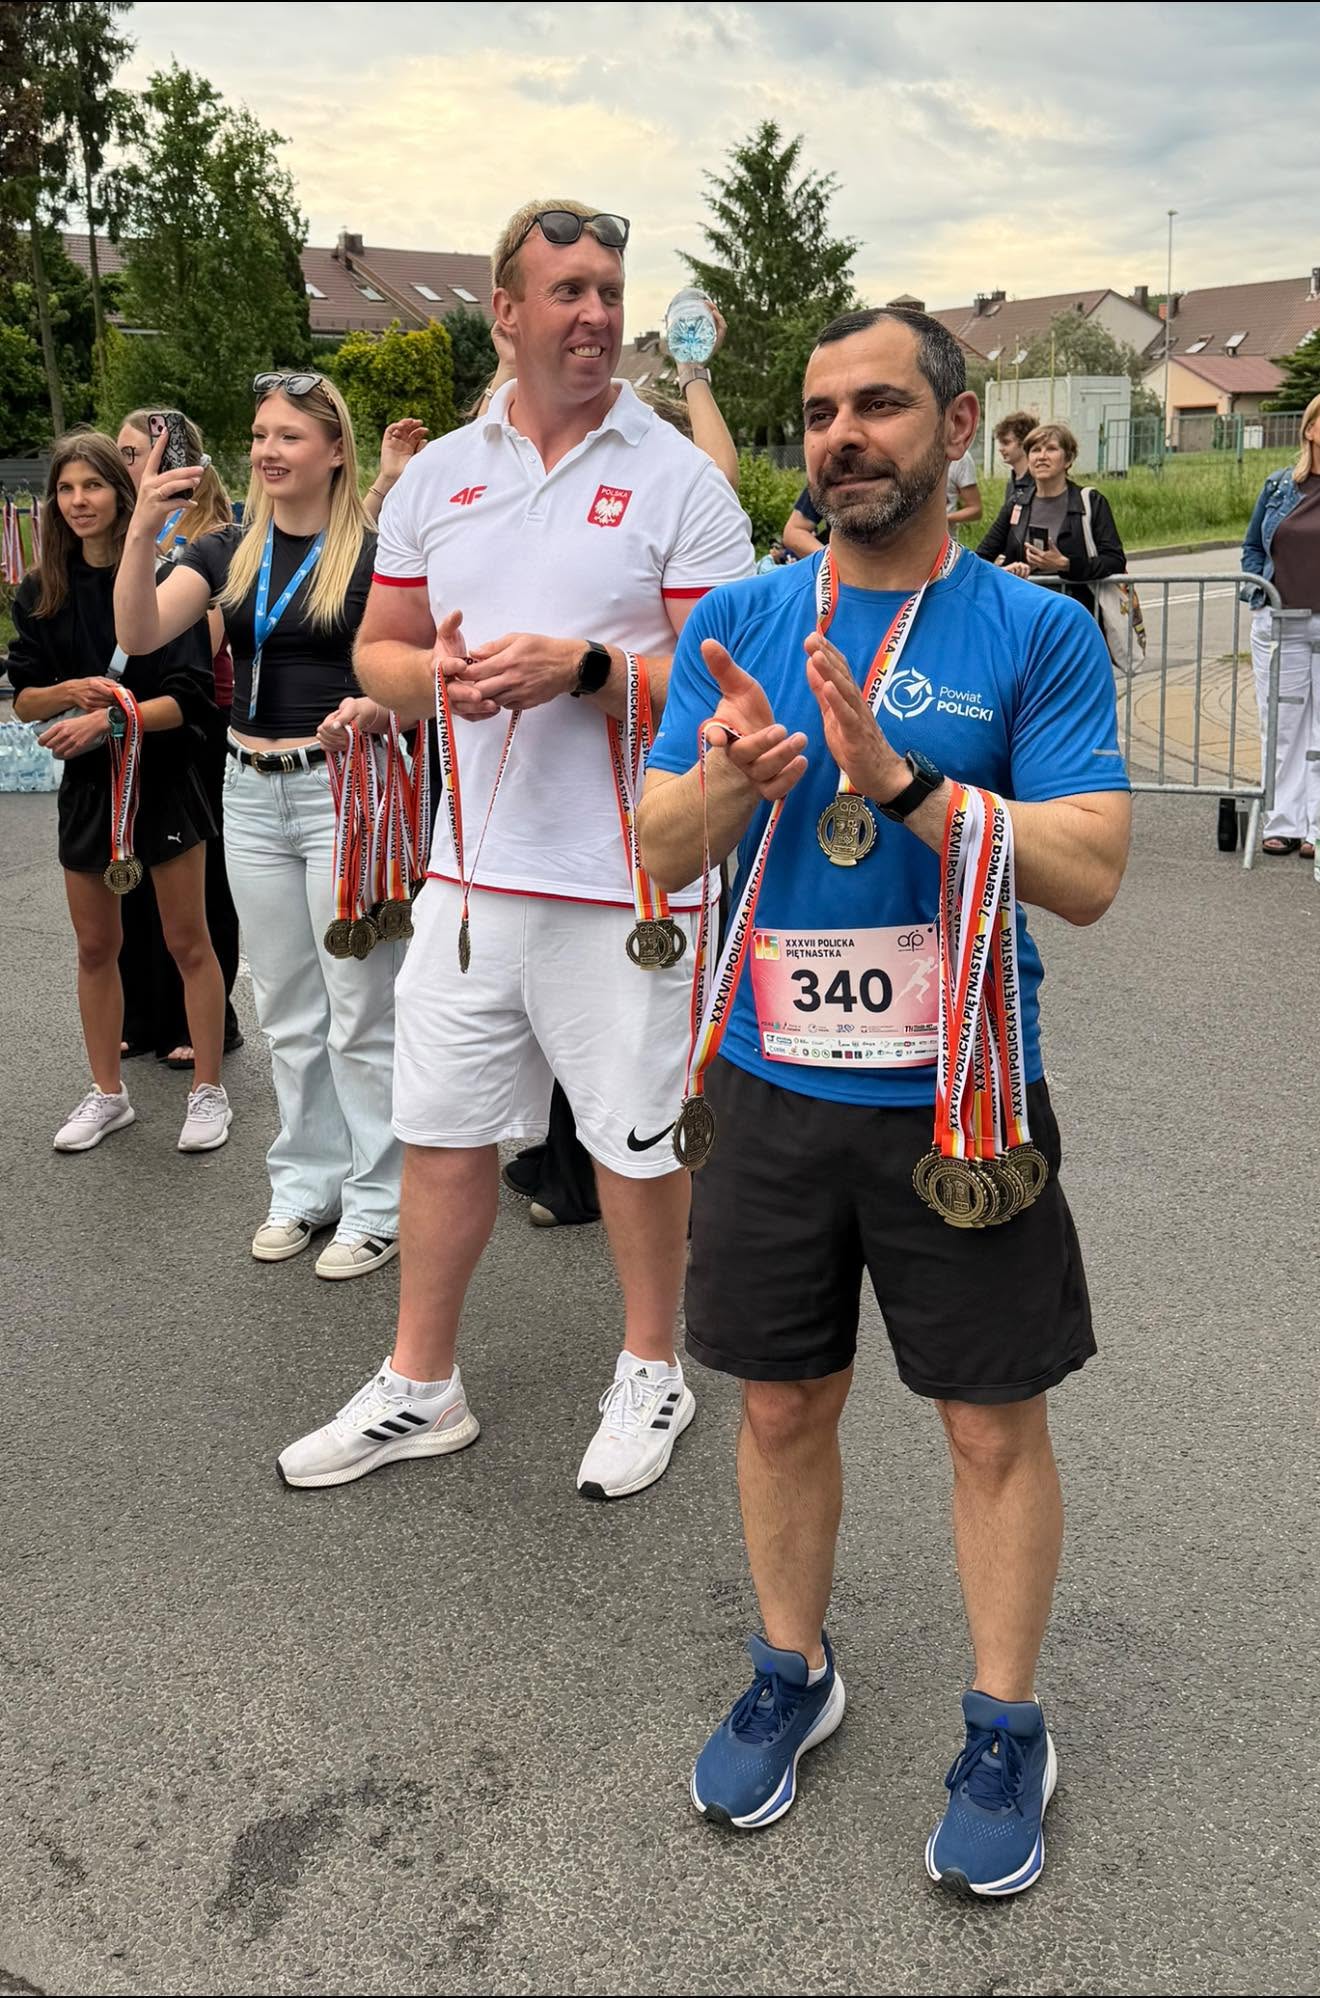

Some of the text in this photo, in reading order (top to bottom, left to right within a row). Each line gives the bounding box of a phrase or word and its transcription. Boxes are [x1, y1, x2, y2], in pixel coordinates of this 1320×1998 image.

[601, 487, 628, 498] POLSKA
[630, 673, 639, 719] POLICKA
[867, 668, 888, 706] 7 czer
[940, 686, 982, 704] Powiat
[936, 702, 994, 722] POLICKI
[439, 710, 452, 776] PIĘTNASTKA
[344, 769, 354, 816] PIĘTNASTKA
[341, 818, 350, 851] POLICKA
[949, 808, 967, 858] XXXVII
[999, 904, 1011, 912] 7
[754, 934, 780, 960] 15
[785, 939, 855, 948] XXXVII POLICKA
[786, 949, 842, 959] PIĘTNASTKA
[710, 973, 733, 1025] XXXVII
[727, 911, 750, 973] POLICKA
[791, 968, 893, 1013] 340
[950, 807, 1005, 1129] XXXVII POLICKA PIĘTNASTKA 7 czerwca 2026
[1001, 927, 1018, 1011] PIĘTNASTKA
[1006, 1012, 1020, 1070] POLICKA
[974, 1040, 987, 1092] XXXVII
[1010, 1073, 1023, 1118] XXXVII
